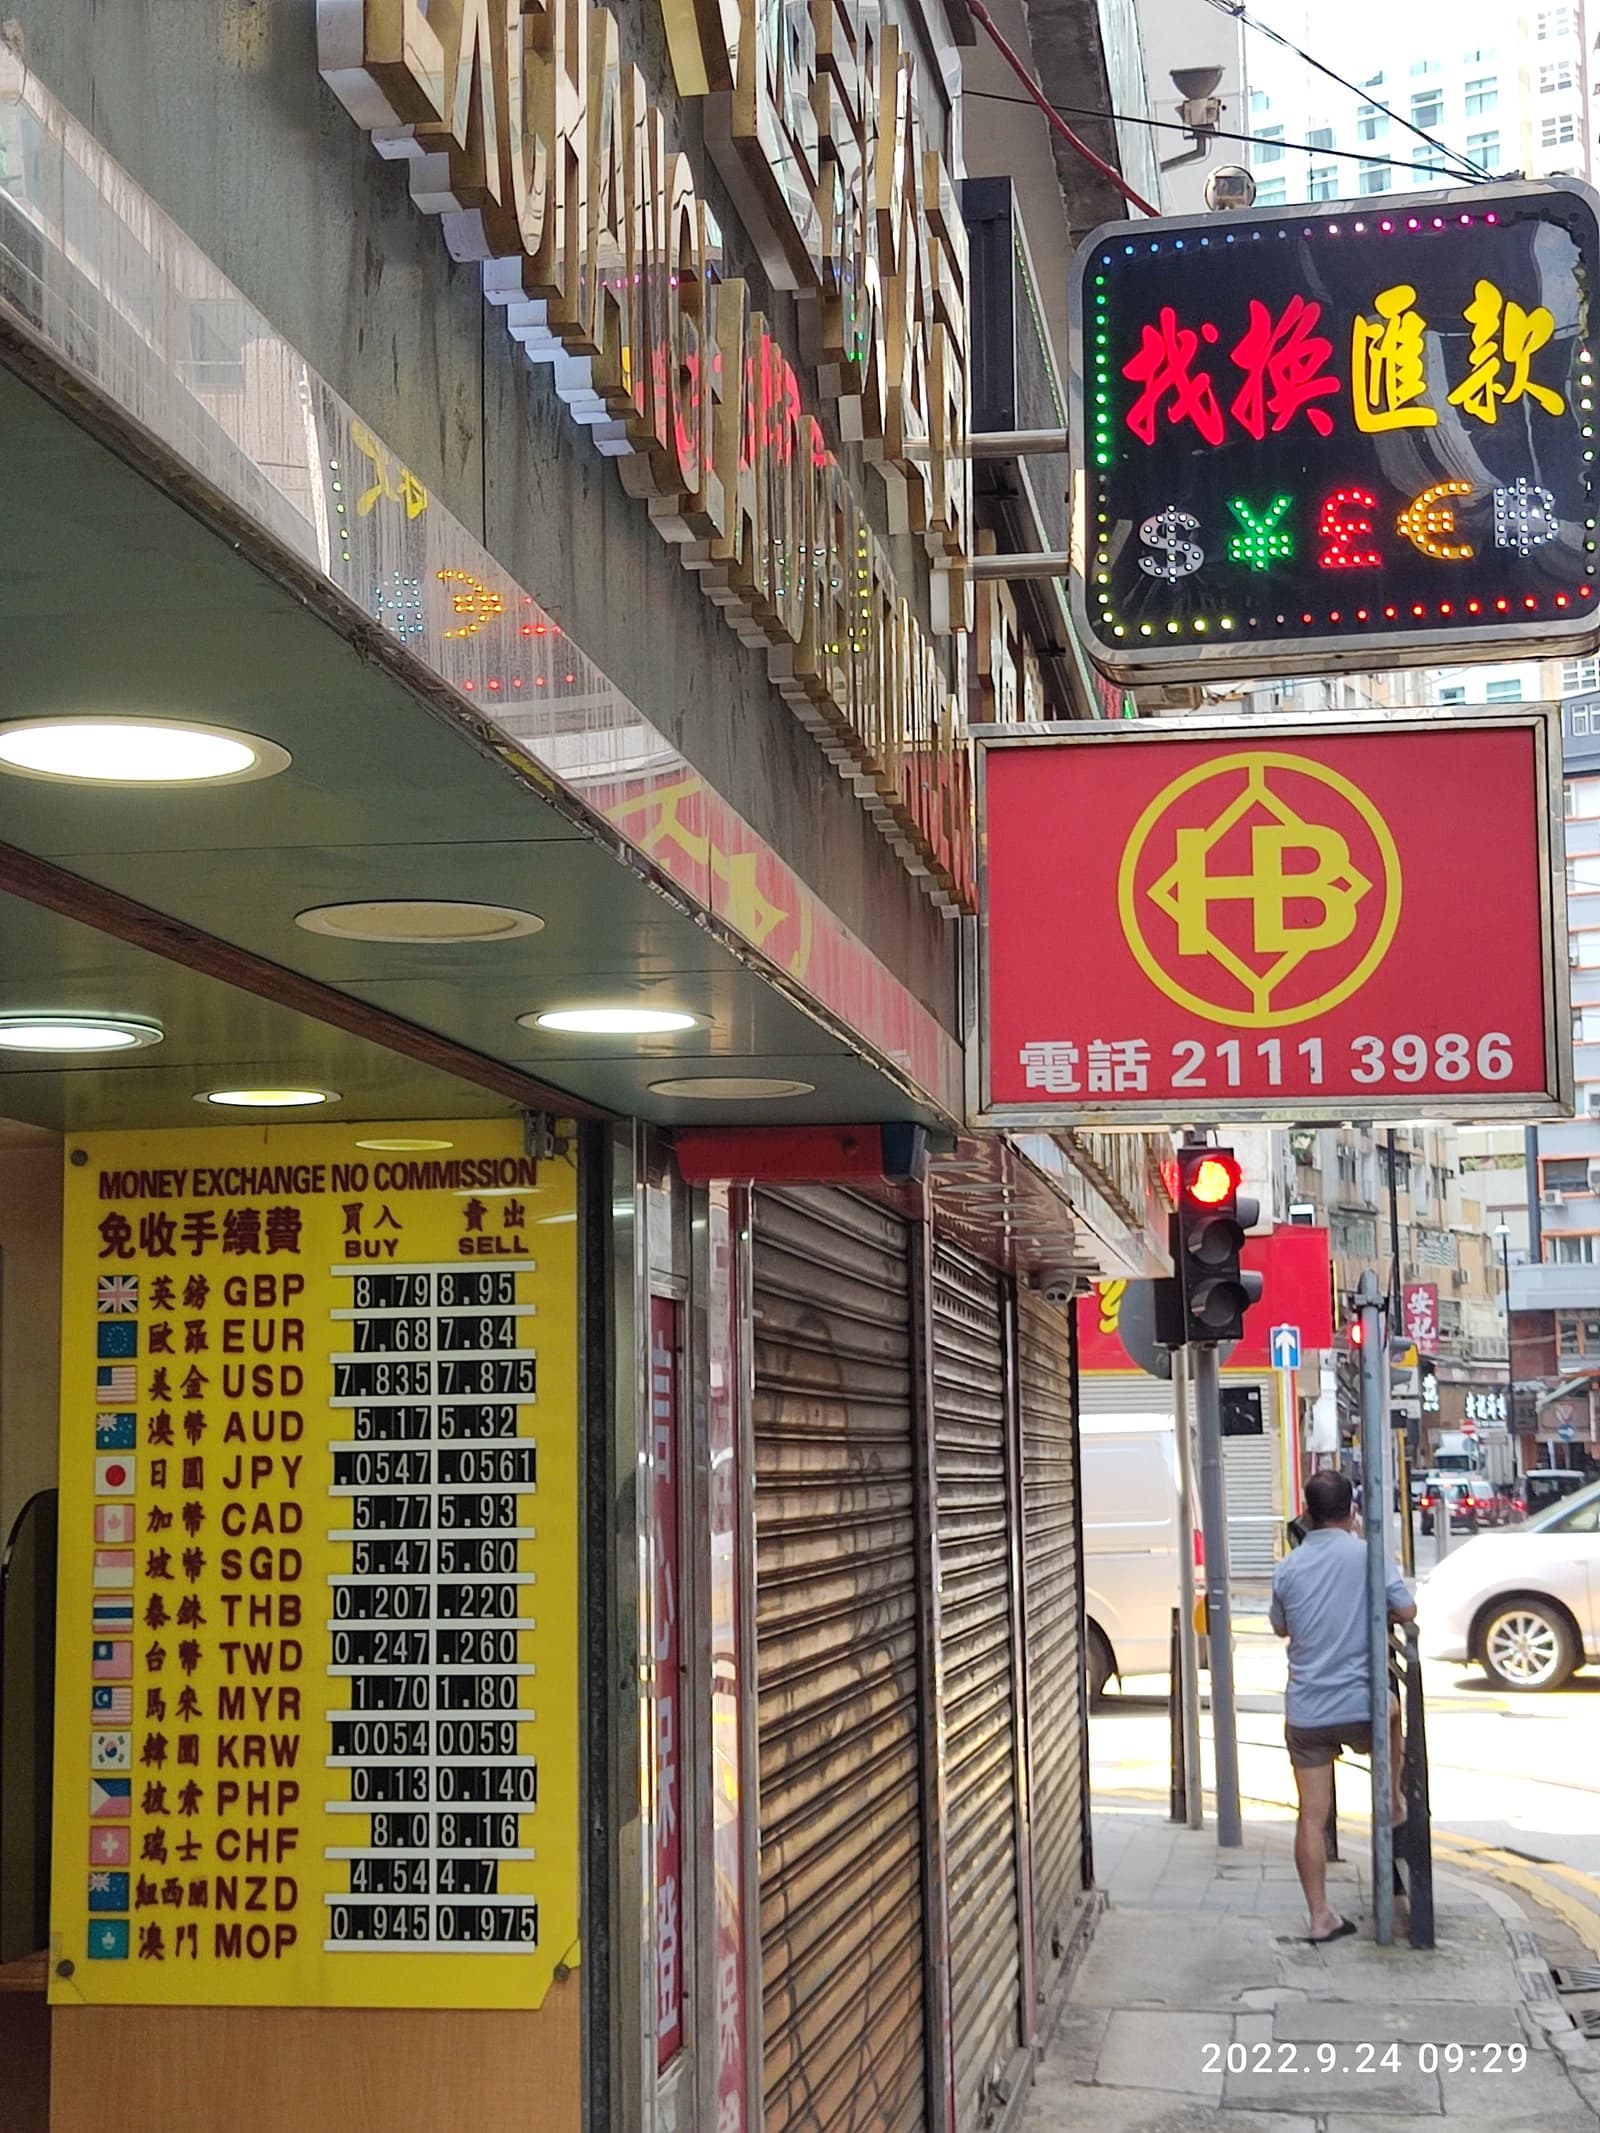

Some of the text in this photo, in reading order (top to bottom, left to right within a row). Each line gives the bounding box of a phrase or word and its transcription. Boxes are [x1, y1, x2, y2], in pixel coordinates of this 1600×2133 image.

[1122, 280, 1567, 447] 找換匯款
[1138, 504, 1206, 585] $
[1228, 495, 1294, 572] ¥
[1319, 486, 1383, 569] £
[1396, 480, 1474, 560] €
[1019, 1032, 1513, 1093] 電話 2111 3986
[98, 1157, 538, 1200] MONEY EXCHANGE NO COMMISSION
[98, 1206, 302, 1259] 免收手續費
[342, 1198, 525, 1235] 買入 賣出
[345, 1235, 528, 1258] BUY SELL
[149, 1274, 513, 1310] 英鎊 GBP 8.79 8.95
[223, 1319, 304, 1353] EUR
[357, 1320, 428, 1352] 7.68
[441, 1318, 513, 1348] 7.84
[148, 1362, 533, 1402] 美金 USD 7.835 7.875
[148, 1406, 514, 1446] 澳幣 AUD 5.17 5.32
[223, 1455, 302, 1489] JPY
[340, 1452, 428, 1484] .0547
[444, 1451, 530, 1482] .0561
[147, 1495, 514, 1537] 加幣 CAD 5.77 5.93
[221, 1547, 302, 1582] SGD
[355, 1542, 428, 1573] 5.47
[441, 1541, 514, 1572] 5.60
[221, 1595, 301, 1627] THB
[336, 1587, 428, 1618] 0.207
[444, 1585, 514, 1617] .220
[146, 1631, 514, 1676] 台幣 TWD 0.247 .260
[218, 1686, 300, 1722] MYR
[356, 1677, 427, 1709] 1.70
[441, 1676, 515, 1708] 1.80
[218, 1734, 299, 1768] KRW
[338, 1723, 427, 1754] .0054
[440, 1723, 514, 1754] 0059
[218, 1781, 299, 1816] PHP
[354, 1768, 427, 1800] 0.13
[440, 1768, 534, 1801] 0.140
[140, 1815, 516, 1864] 瑞士 CHF 8.0 8.16
[216, 1876, 297, 1911] NZD
[353, 1860, 427, 1892] 4.54
[440, 1860, 497, 1892] 4.7
[139, 1907, 535, 1960] 澳門 MOP 0.945 0.975
